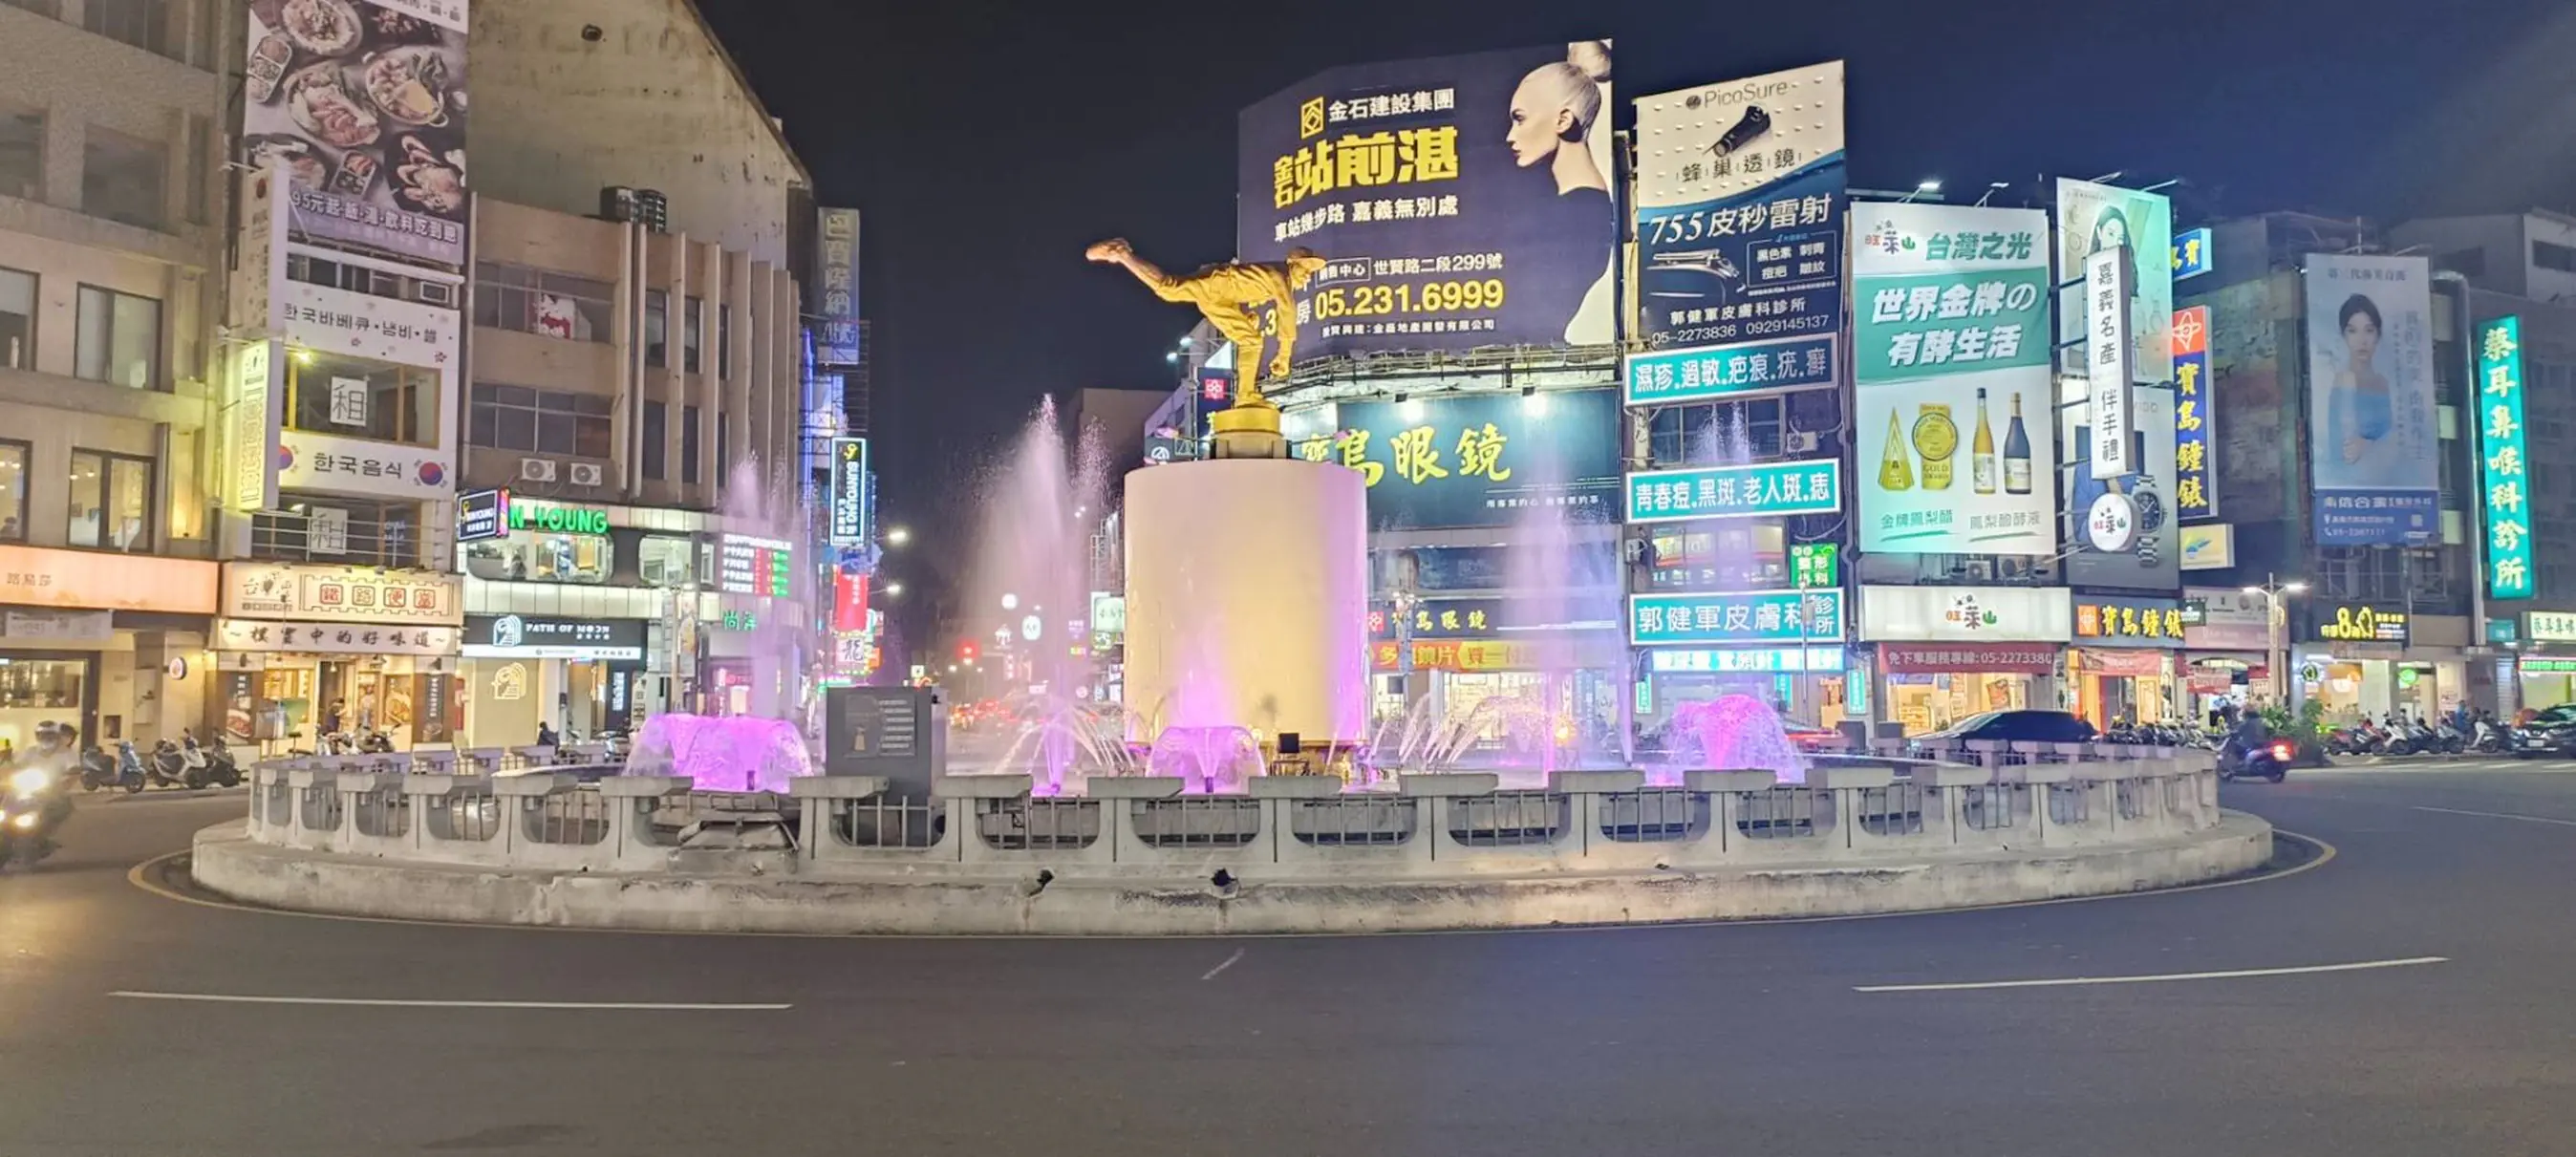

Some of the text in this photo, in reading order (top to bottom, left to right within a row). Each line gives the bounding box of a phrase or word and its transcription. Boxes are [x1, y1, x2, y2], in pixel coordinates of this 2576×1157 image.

[1328, 88, 1454, 122] 金石建設集團
[1704, 81, 1788, 108] PicoSure
[1275, 195, 1459, 242] 車站幾步路 嘉義無別處
[1926, 231, 2032, 261] 台灣之光
[1373, 252, 1504, 276] 世賢路二段299號
[1315, 279, 1504, 321] 05.231.6999
[1669, 297, 1806, 326] 郭健軍皮膚科診所
[1872, 280, 2037, 324] 世界金牌の
[2097, 261, 2117, 366] 嘉義名產
[1652, 314, 1830, 344] 05-2273836 0929145137
[314, 452, 401, 479] 한국음식
[2483, 327, 2527, 589] 蔡耳鼻喉科診所
[534, 505, 608, 534] YOUNG
[559, 624, 572, 632] OF
